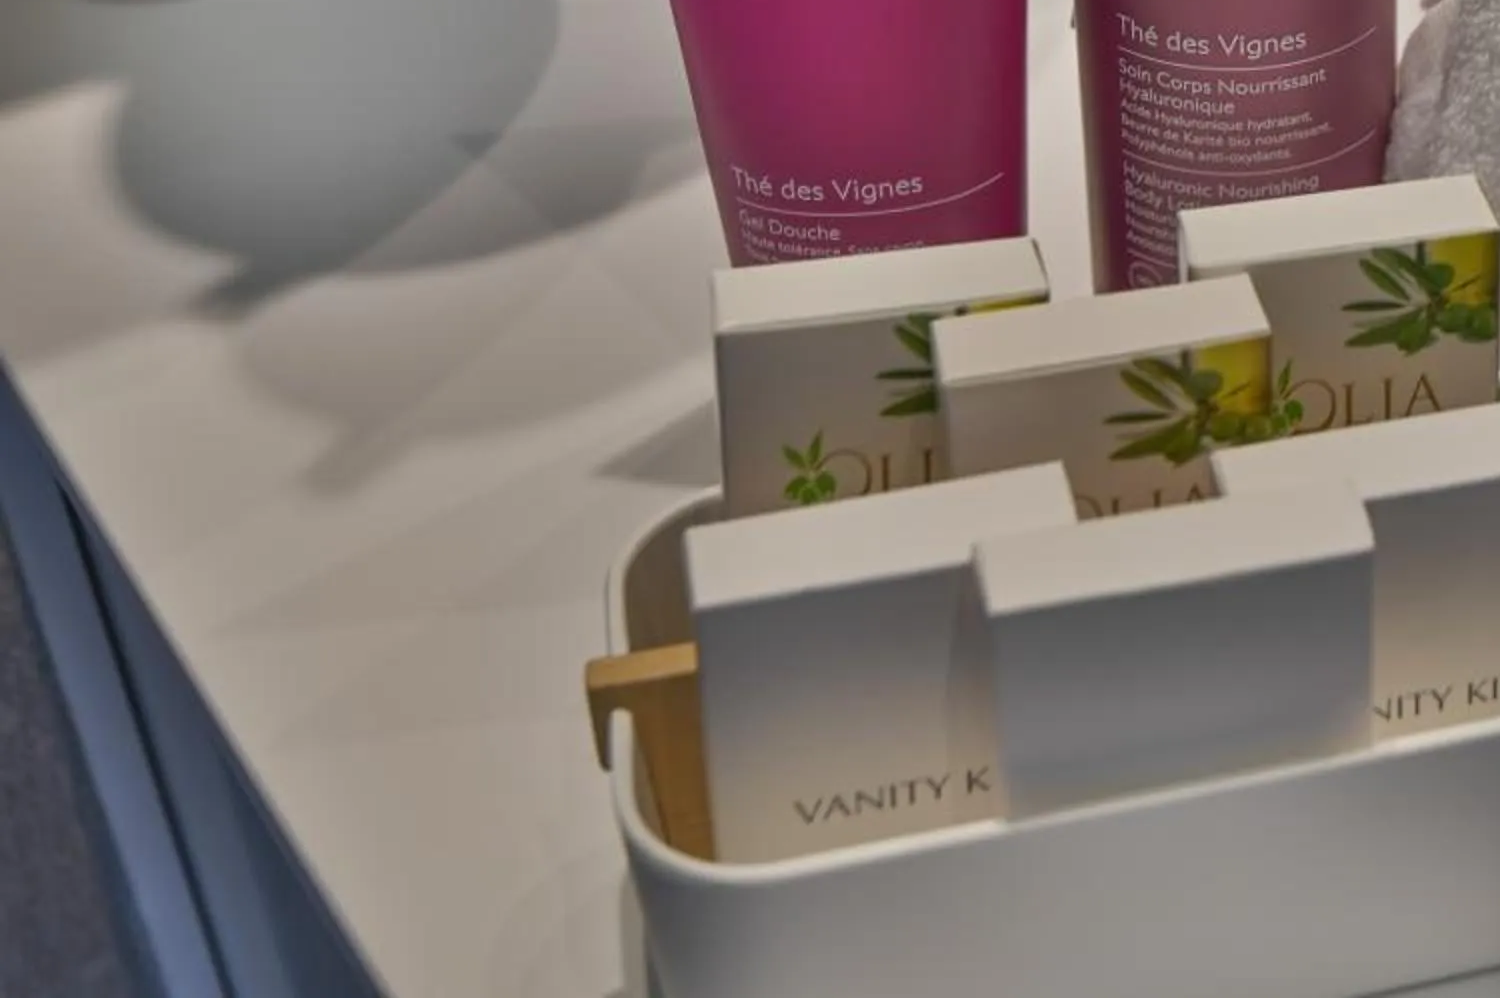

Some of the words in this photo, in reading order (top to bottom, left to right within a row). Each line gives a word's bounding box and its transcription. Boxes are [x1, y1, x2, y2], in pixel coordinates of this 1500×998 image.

[1117, 12, 1158, 46] Thé
[1166, 31, 1210, 55] des
[1217, 32, 1307, 60] Vignes
[1119, 57, 1151, 82] Soin
[1157, 71, 1212, 95] Corps
[1219, 68, 1327, 95] Nourrissant
[1119, 78, 1236, 116] Hyaluronique
[732, 165, 772, 197] Thé
[781, 179, 824, 201] des
[832, 176, 923, 204] Vignes
[1123, 160, 1213, 197] Hyaluronic
[1219, 174, 1320, 199] Nourishing
[739, 209, 763, 230] Gel
[769, 218, 841, 241] Douche
[1283, 373, 1441, 436] OLIA
[1373, 685, 1453, 723] NITY
[793, 772, 951, 825] VANITY
